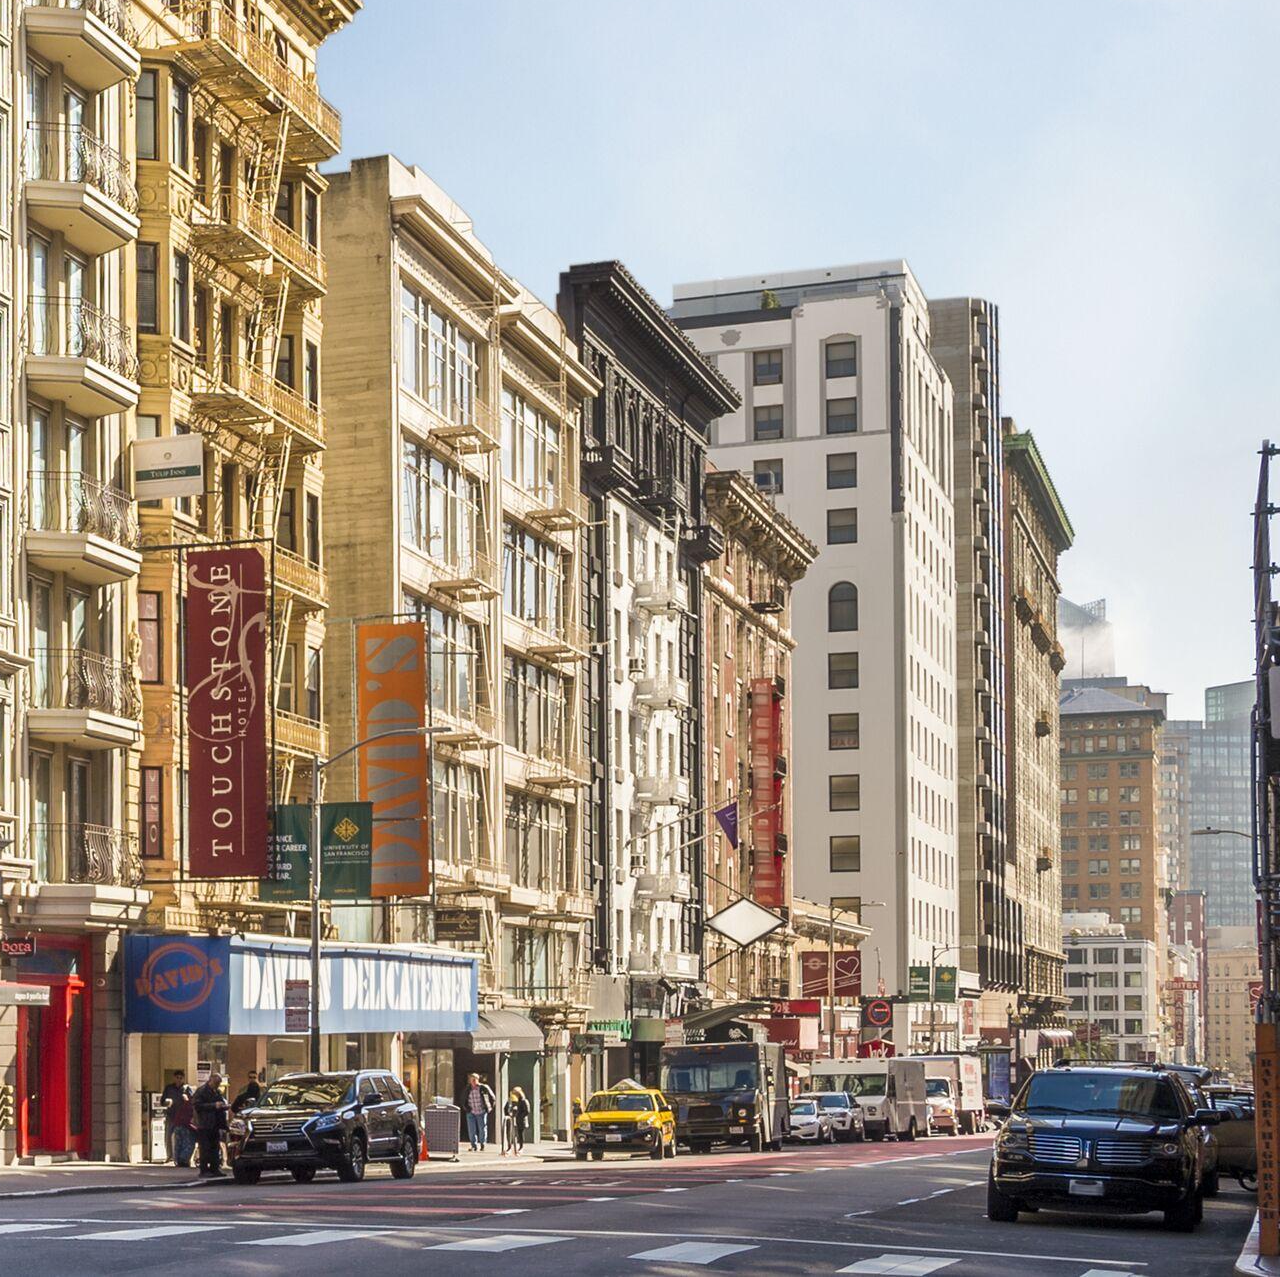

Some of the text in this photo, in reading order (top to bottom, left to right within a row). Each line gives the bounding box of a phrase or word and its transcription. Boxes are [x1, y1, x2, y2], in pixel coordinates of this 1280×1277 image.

[211, 564, 233, 857] TOUCHSTONE
[237, 685, 247, 736] HOTEL
[365, 634, 423, 887] DAVID'S
[281, 844, 307, 852] CAREER
[134, 956, 224, 998] DAVID'S
[343, 957, 471, 1012] DELICATESSEN
[1166, 982, 1198, 990] BRITEX
[1261, 1059, 1272, 1086] BAY
[1262, 1090, 1273, 1127] AREA
[1262, 1131, 1273, 1168] HIGH
